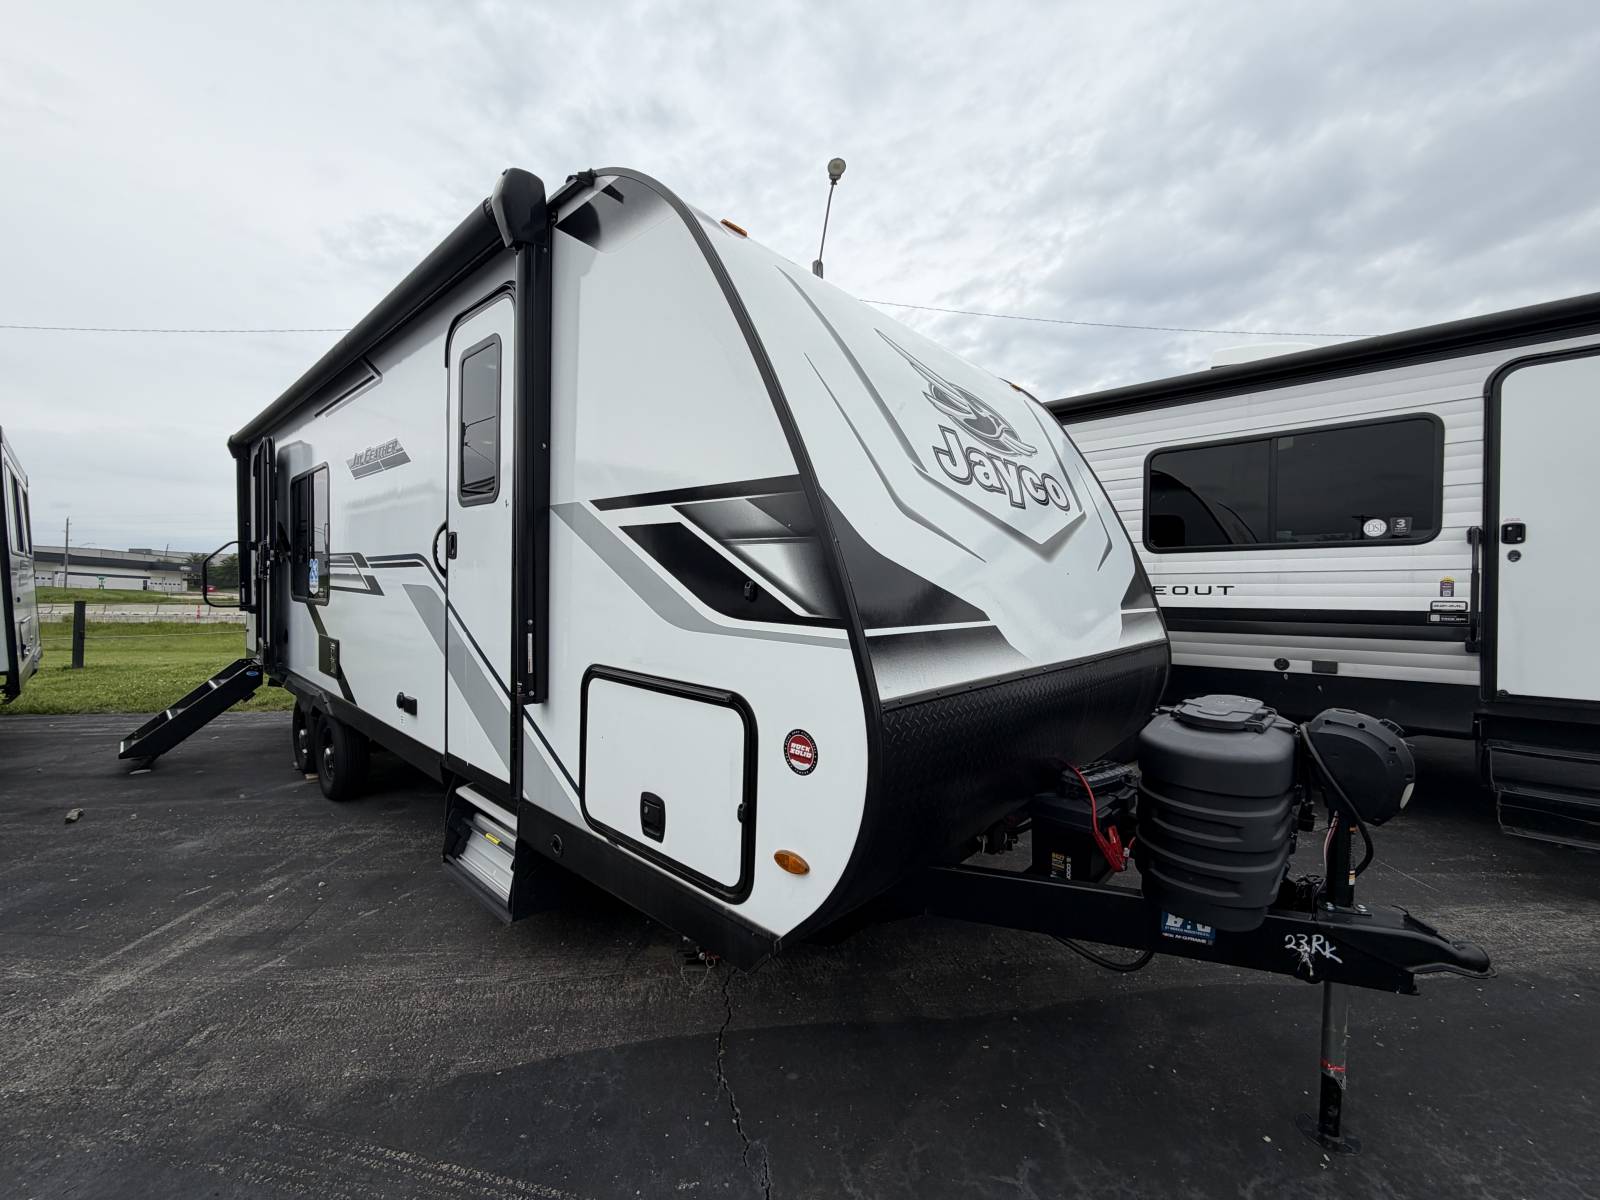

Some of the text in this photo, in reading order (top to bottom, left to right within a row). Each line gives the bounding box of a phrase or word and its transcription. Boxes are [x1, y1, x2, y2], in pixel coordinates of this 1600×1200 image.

[931, 423, 1070, 512] Jayco
[1396, 519, 1406, 528] 3
[791, 742, 811, 752] ROCK
[790, 748, 812, 758] SOLID
